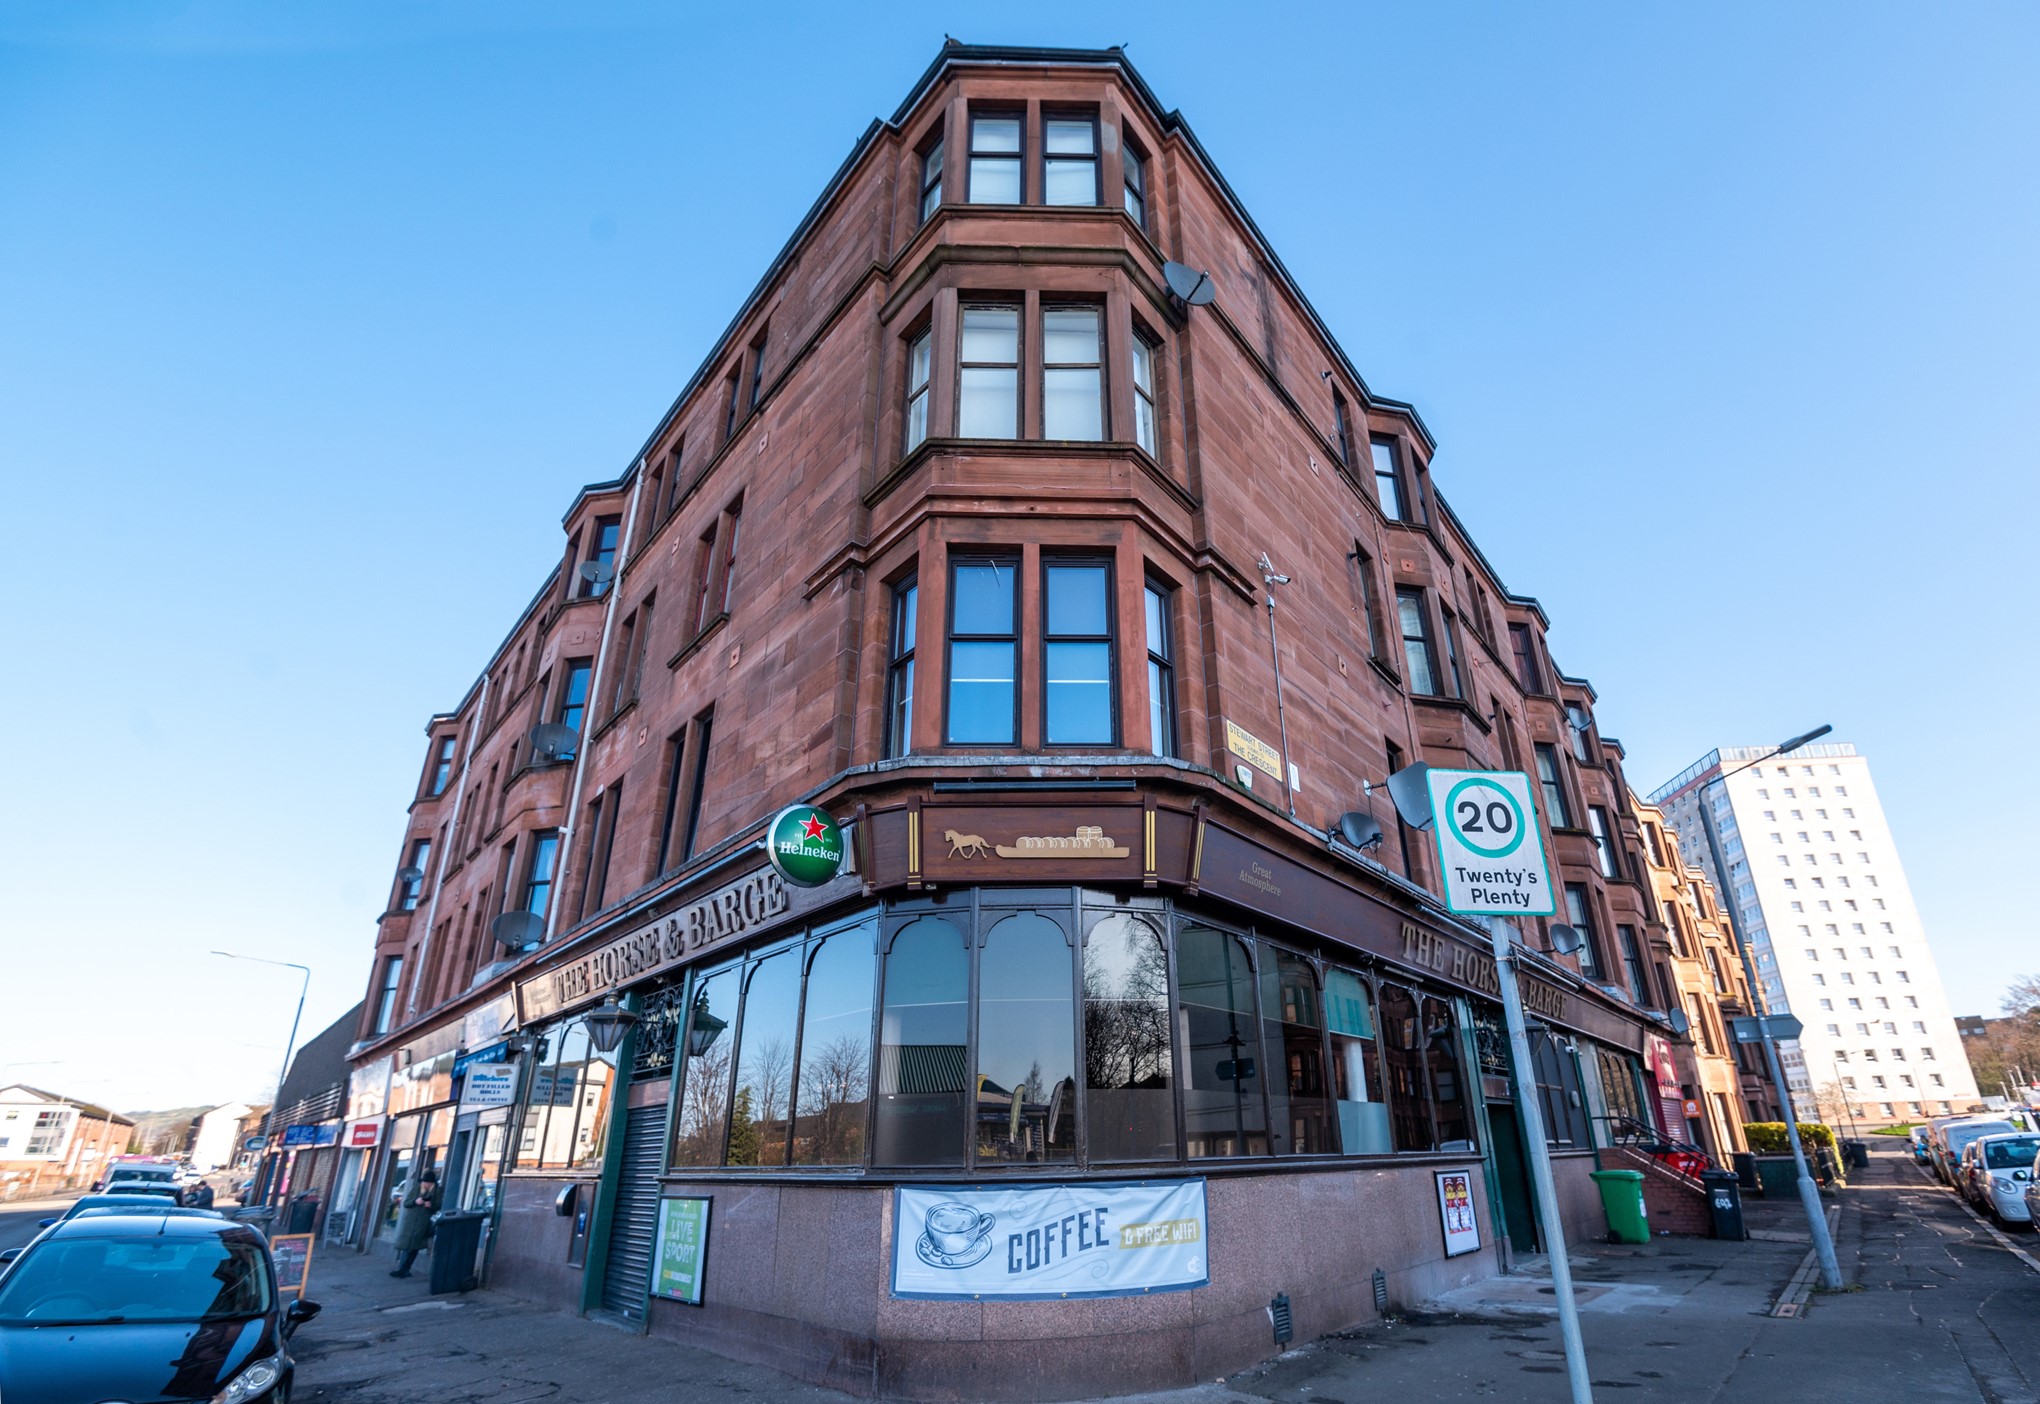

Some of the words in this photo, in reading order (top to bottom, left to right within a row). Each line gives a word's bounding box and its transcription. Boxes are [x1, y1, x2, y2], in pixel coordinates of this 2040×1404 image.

[1229, 723, 1256, 748] STEWART
[1258, 742, 1279, 762] STREET
[1233, 742, 1246, 757] THE
[1247, 751, 1277, 776] CRESCENT
[1457, 801, 1513, 833] 20
[780, 841, 840, 862] Heineken
[1239, 869, 1281, 897] Atmosphere
[1252, 861, 1272, 880] Great
[1455, 867, 1537, 886] Twenty's
[1471, 888, 1530, 907] Plenty
[554, 962, 589, 1002] THE
[592, 928, 660, 990] HORSE
[662, 918, 684, 960] &
[688, 872, 786, 949] BARGE
[1402, 921, 1446, 973] THE
[1451, 944, 1502, 996] HORS
[1528, 980, 1568, 1020] BARGE
[671, 1219, 694, 1242] LIVE
[1008, 1207, 1109, 1274] COFFEE
[1136, 1225, 1168, 1244] FREE
[664, 1241, 695, 1264] SPORT
